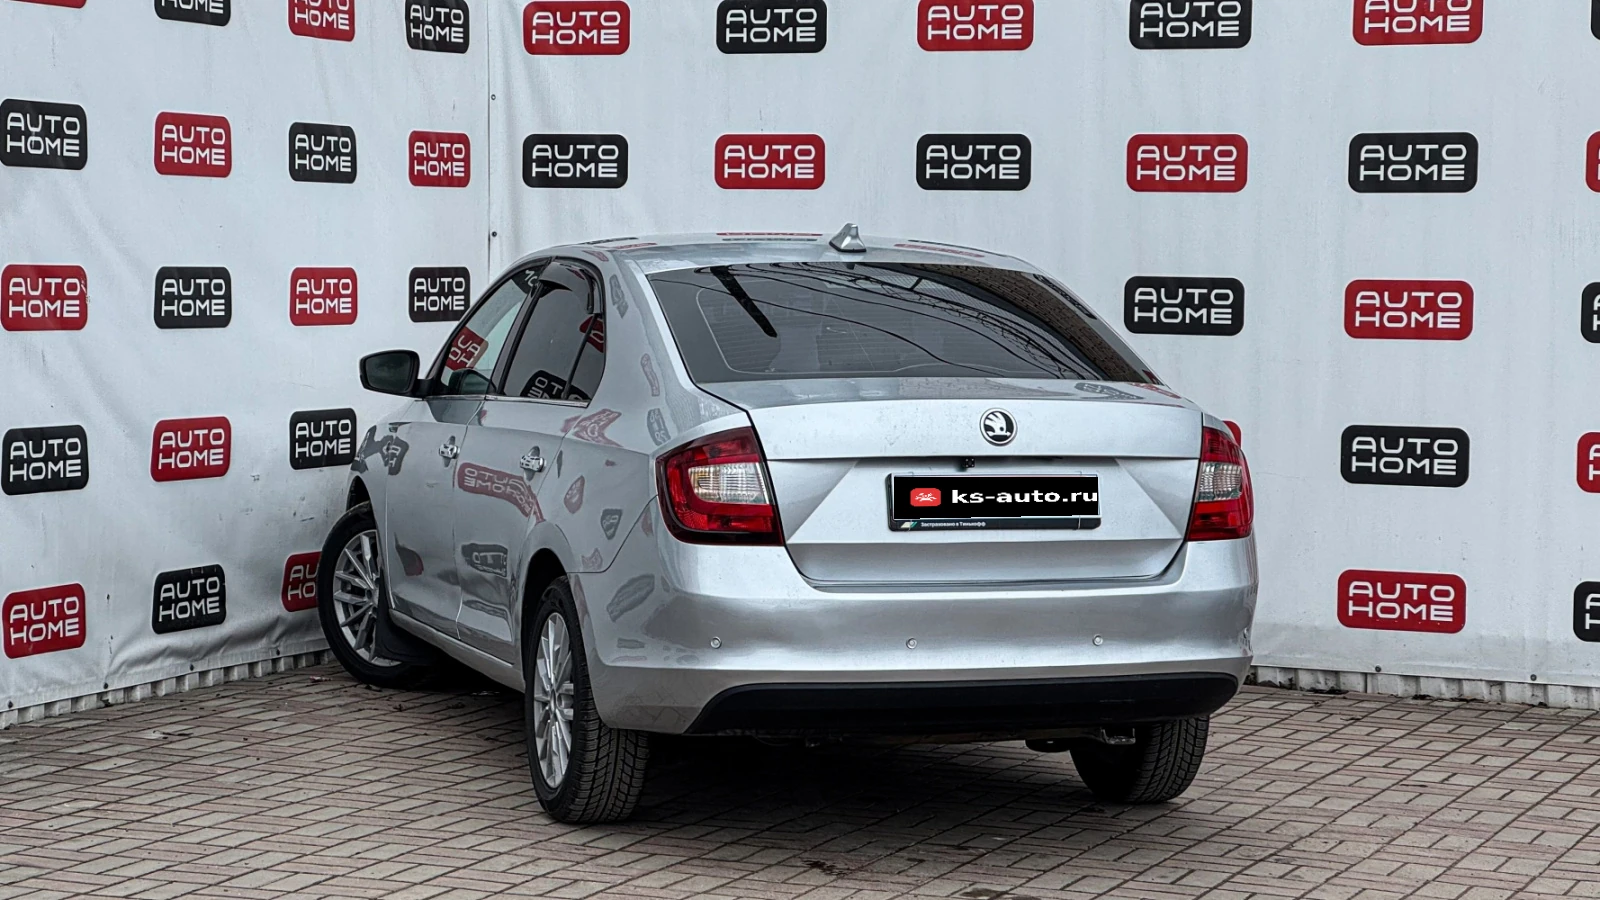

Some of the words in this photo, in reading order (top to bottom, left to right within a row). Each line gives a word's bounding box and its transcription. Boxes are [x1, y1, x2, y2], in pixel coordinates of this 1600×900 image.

[410, 5, 463, 24] AUTO
[928, 5, 1023, 21] AUTO
[1141, 1, 1241, 18] AUTO
[1365, 0, 1472, 13] AUTO
[295, 7, 349, 30] HOME
[533, 11, 620, 26] AUTO
[726, 8, 817, 24] AUTO
[1364, 15, 1470, 33] HOME
[410, 23, 463, 42] HOME
[532, 29, 619, 44] HOME
[726, 27, 815, 42] HOME
[928, 24, 1022, 40] HOME
[1140, 21, 1239, 37] HOME
[7, 113, 80, 135] AUTO
[162, 125, 225, 145] AUTO
[295, 134, 351, 152] AUTO
[7, 135, 79, 157] HOME
[414, 142, 465, 158] AUTO
[533, 145, 618, 159] AUTO
[725, 145, 815, 160] AUTO
[926, 145, 1021, 160] AUTO
[1137, 146, 1237, 161] AUTO
[1361, 145, 1466, 161] AUTO
[162, 145, 225, 165] HOME
[295, 154, 351, 172] HOME
[415, 160, 464, 176] HOME
[532, 163, 617, 177] HOME
[724, 164, 814, 178] HOME
[926, 164, 1019, 179] HOME
[1137, 165, 1235, 180] HOME
[1360, 165, 1464, 181] HOME
[9, 278, 80, 295] AUTO
[162, 279, 225, 295] AUTO
[296, 279, 352, 294] AUTO
[415, 278, 465, 293] AUTO
[414, 296, 464, 311] HOME
[1135, 288, 1233, 304] AUTO
[1356, 291, 1462, 308] AUTO
[9, 300, 79, 317] HOME
[162, 299, 225, 316] HOME
[296, 298, 351, 314] HOME
[1134, 307, 1231, 324] HOME
[1355, 311, 1460, 328] HOME
[296, 419, 351, 438] AUTO
[160, 429, 224, 449] AUTO
[1352, 437, 1458, 455] AUTO
[10, 438, 81, 459] AUTO
[296, 438, 350, 458] HOME
[159, 449, 223, 469] HOME
[1352, 456, 1456, 475] HOME
[10, 459, 81, 482] HOME
[290, 563, 319, 581] AU
[161, 577, 219, 601] AUTO
[288, 582, 316, 600] HO
[1349, 581, 1454, 601] AUTO
[10, 597, 79, 623] AUTO
[159, 597, 219, 621] HOME
[1349, 600, 1453, 621] HOME
[10, 618, 79, 645] HOME
